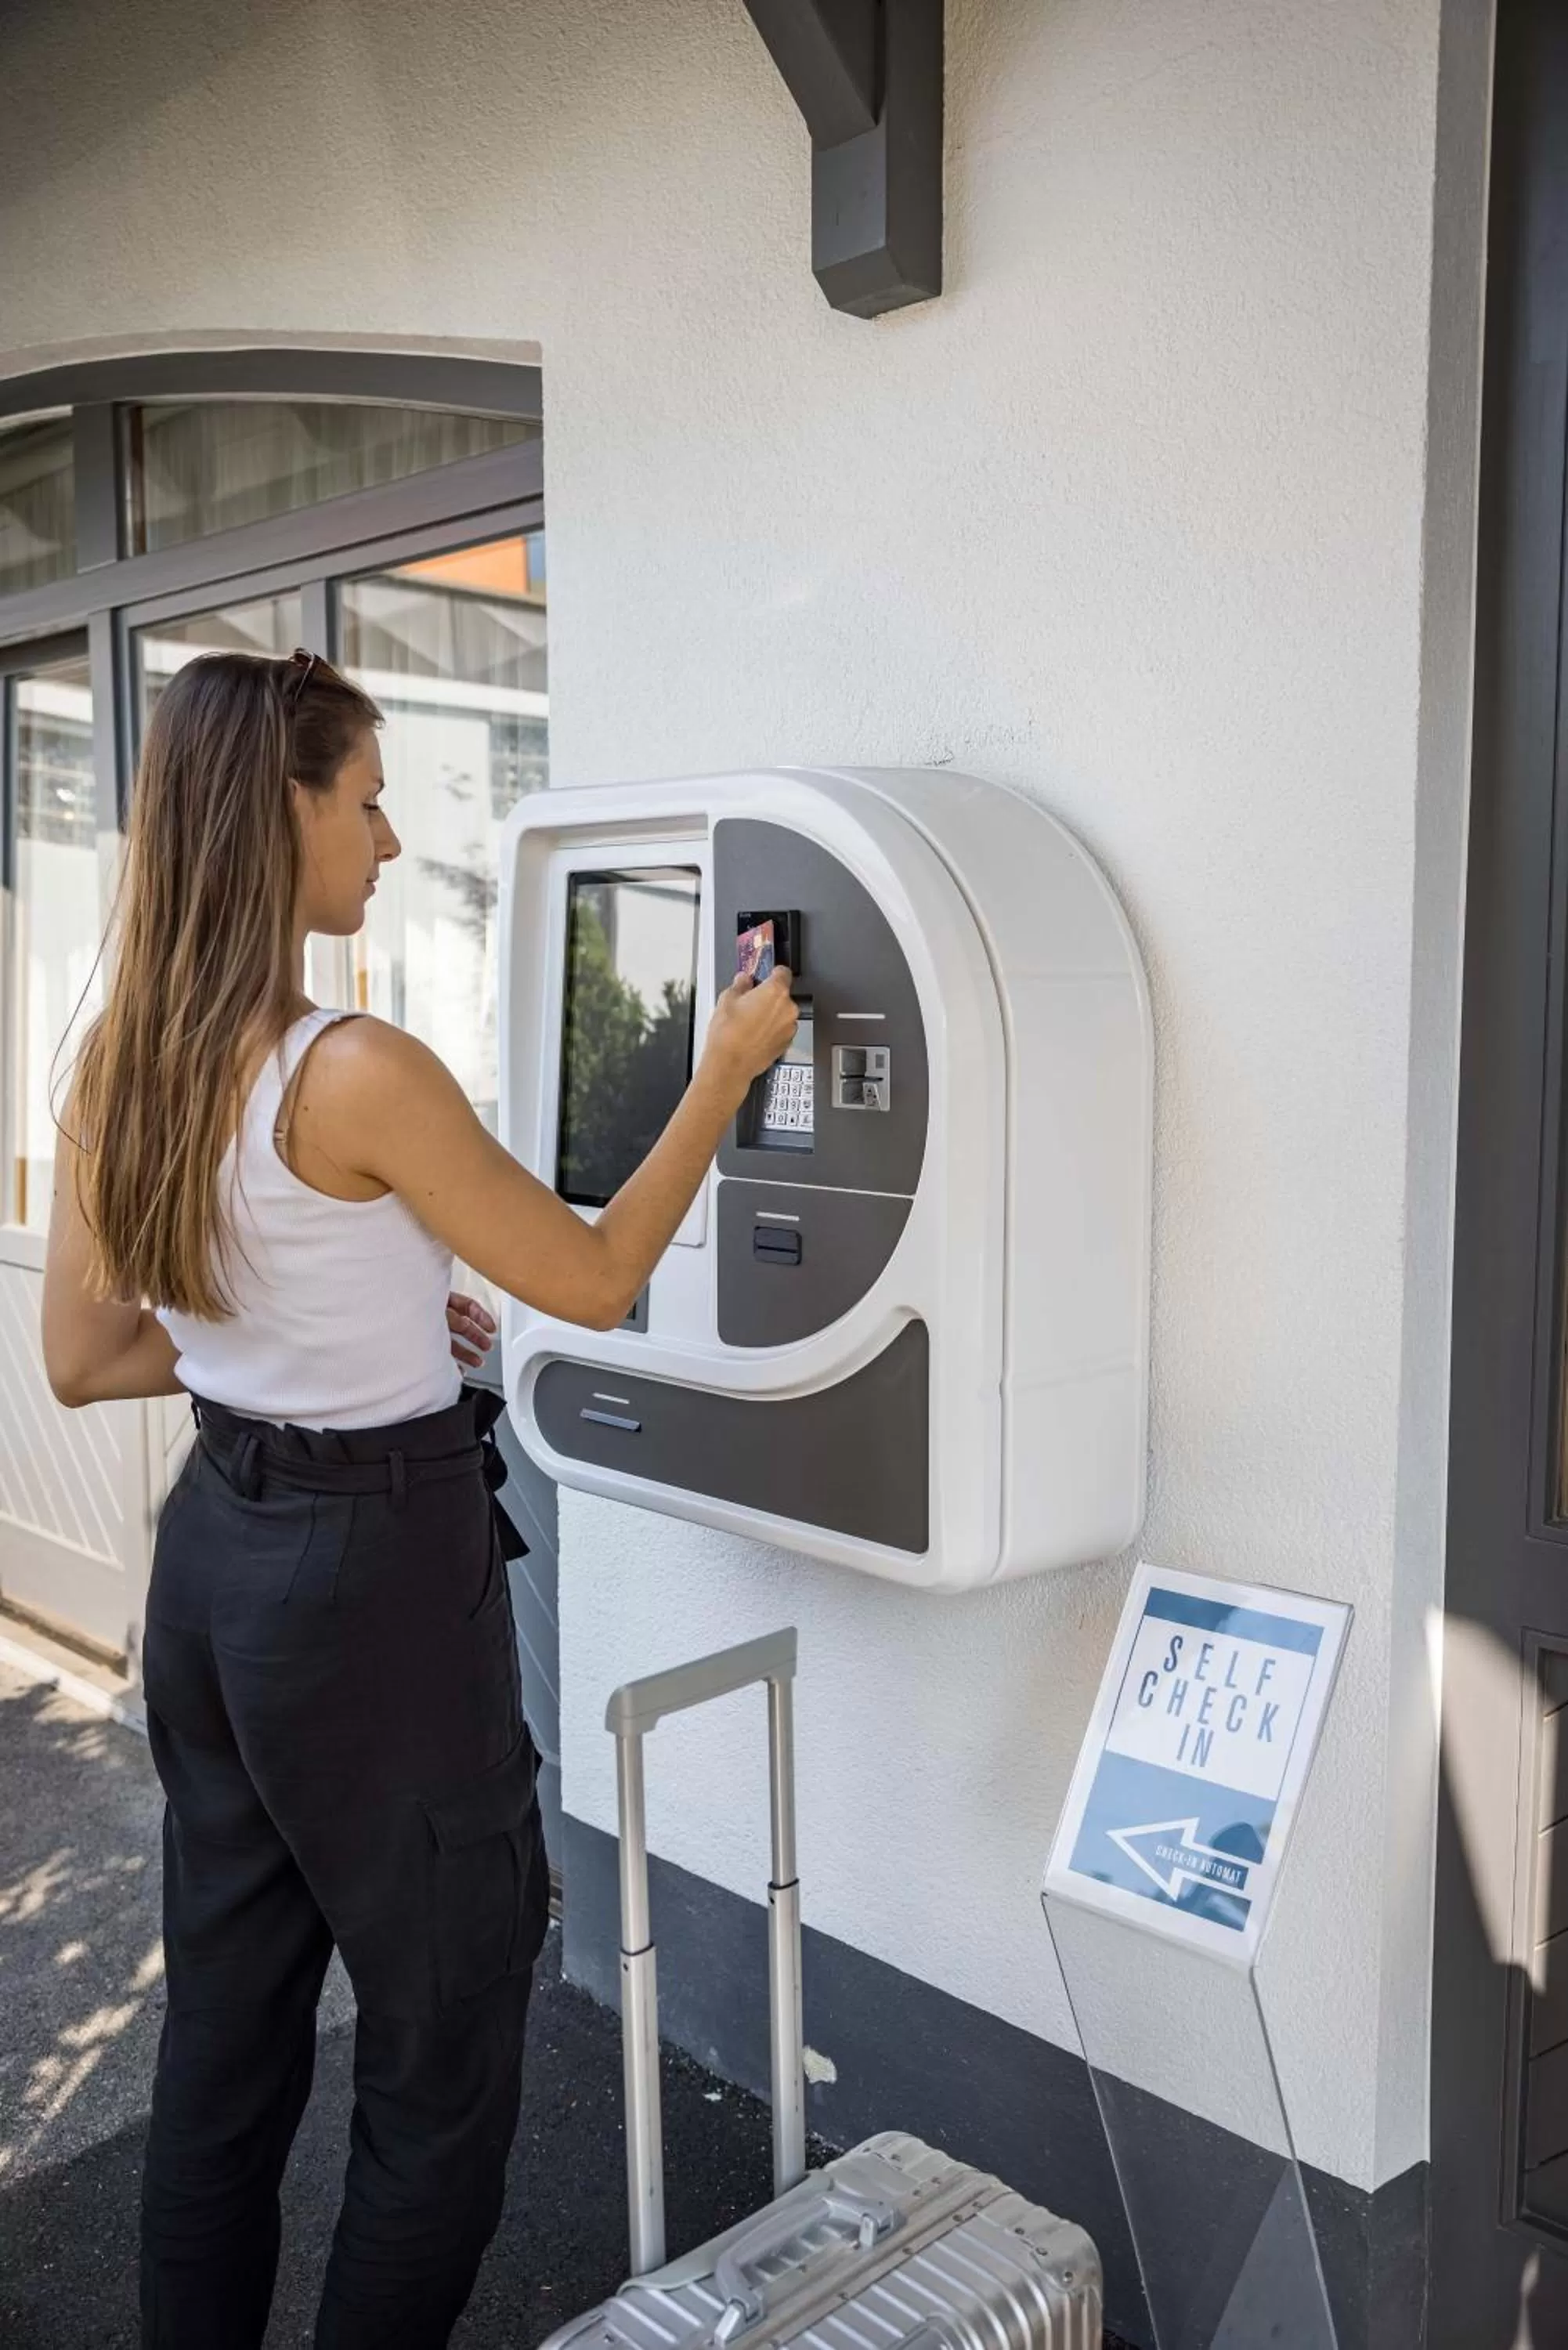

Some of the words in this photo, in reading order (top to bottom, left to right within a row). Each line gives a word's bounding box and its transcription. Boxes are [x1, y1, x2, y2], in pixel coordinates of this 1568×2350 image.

[1163, 1635, 1277, 1696] SELF
[1138, 1670, 1281, 1743] CHECK
[1176, 1723, 1215, 1768] IN
[1155, 1845, 1198, 1869] CHECK-IN
[1199, 1863, 1242, 1883] AUTOMAT
